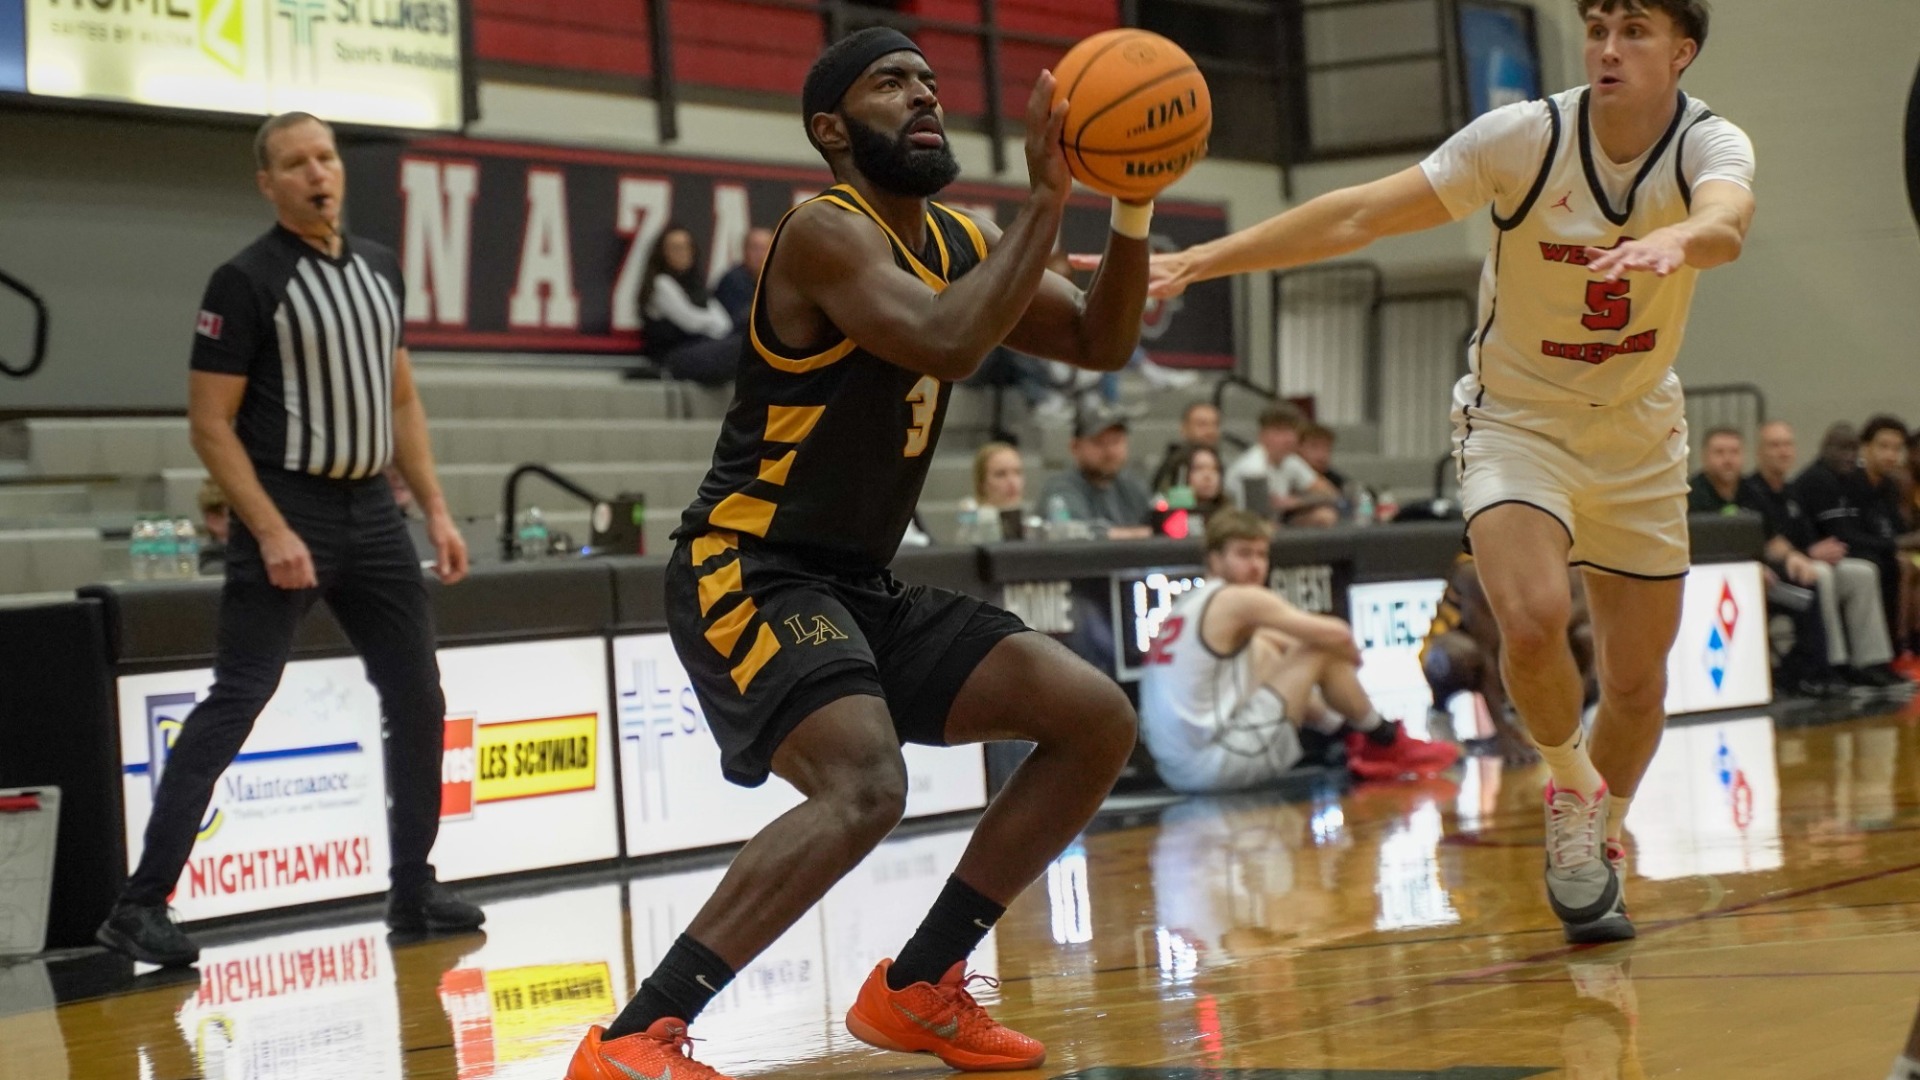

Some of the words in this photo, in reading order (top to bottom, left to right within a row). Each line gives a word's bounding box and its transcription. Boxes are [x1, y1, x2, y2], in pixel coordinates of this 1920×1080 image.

[1539, 236, 1637, 266] WE
[1581, 278, 1631, 331] 5
[905, 374, 940, 457] 3
[784, 613, 849, 645] LA
[480, 744, 508, 781] LES
[514, 736, 589, 777] SCHWAB
[225, 771, 349, 804] Maintenance
[187, 836, 371, 898] NIGHTHAWKS!
